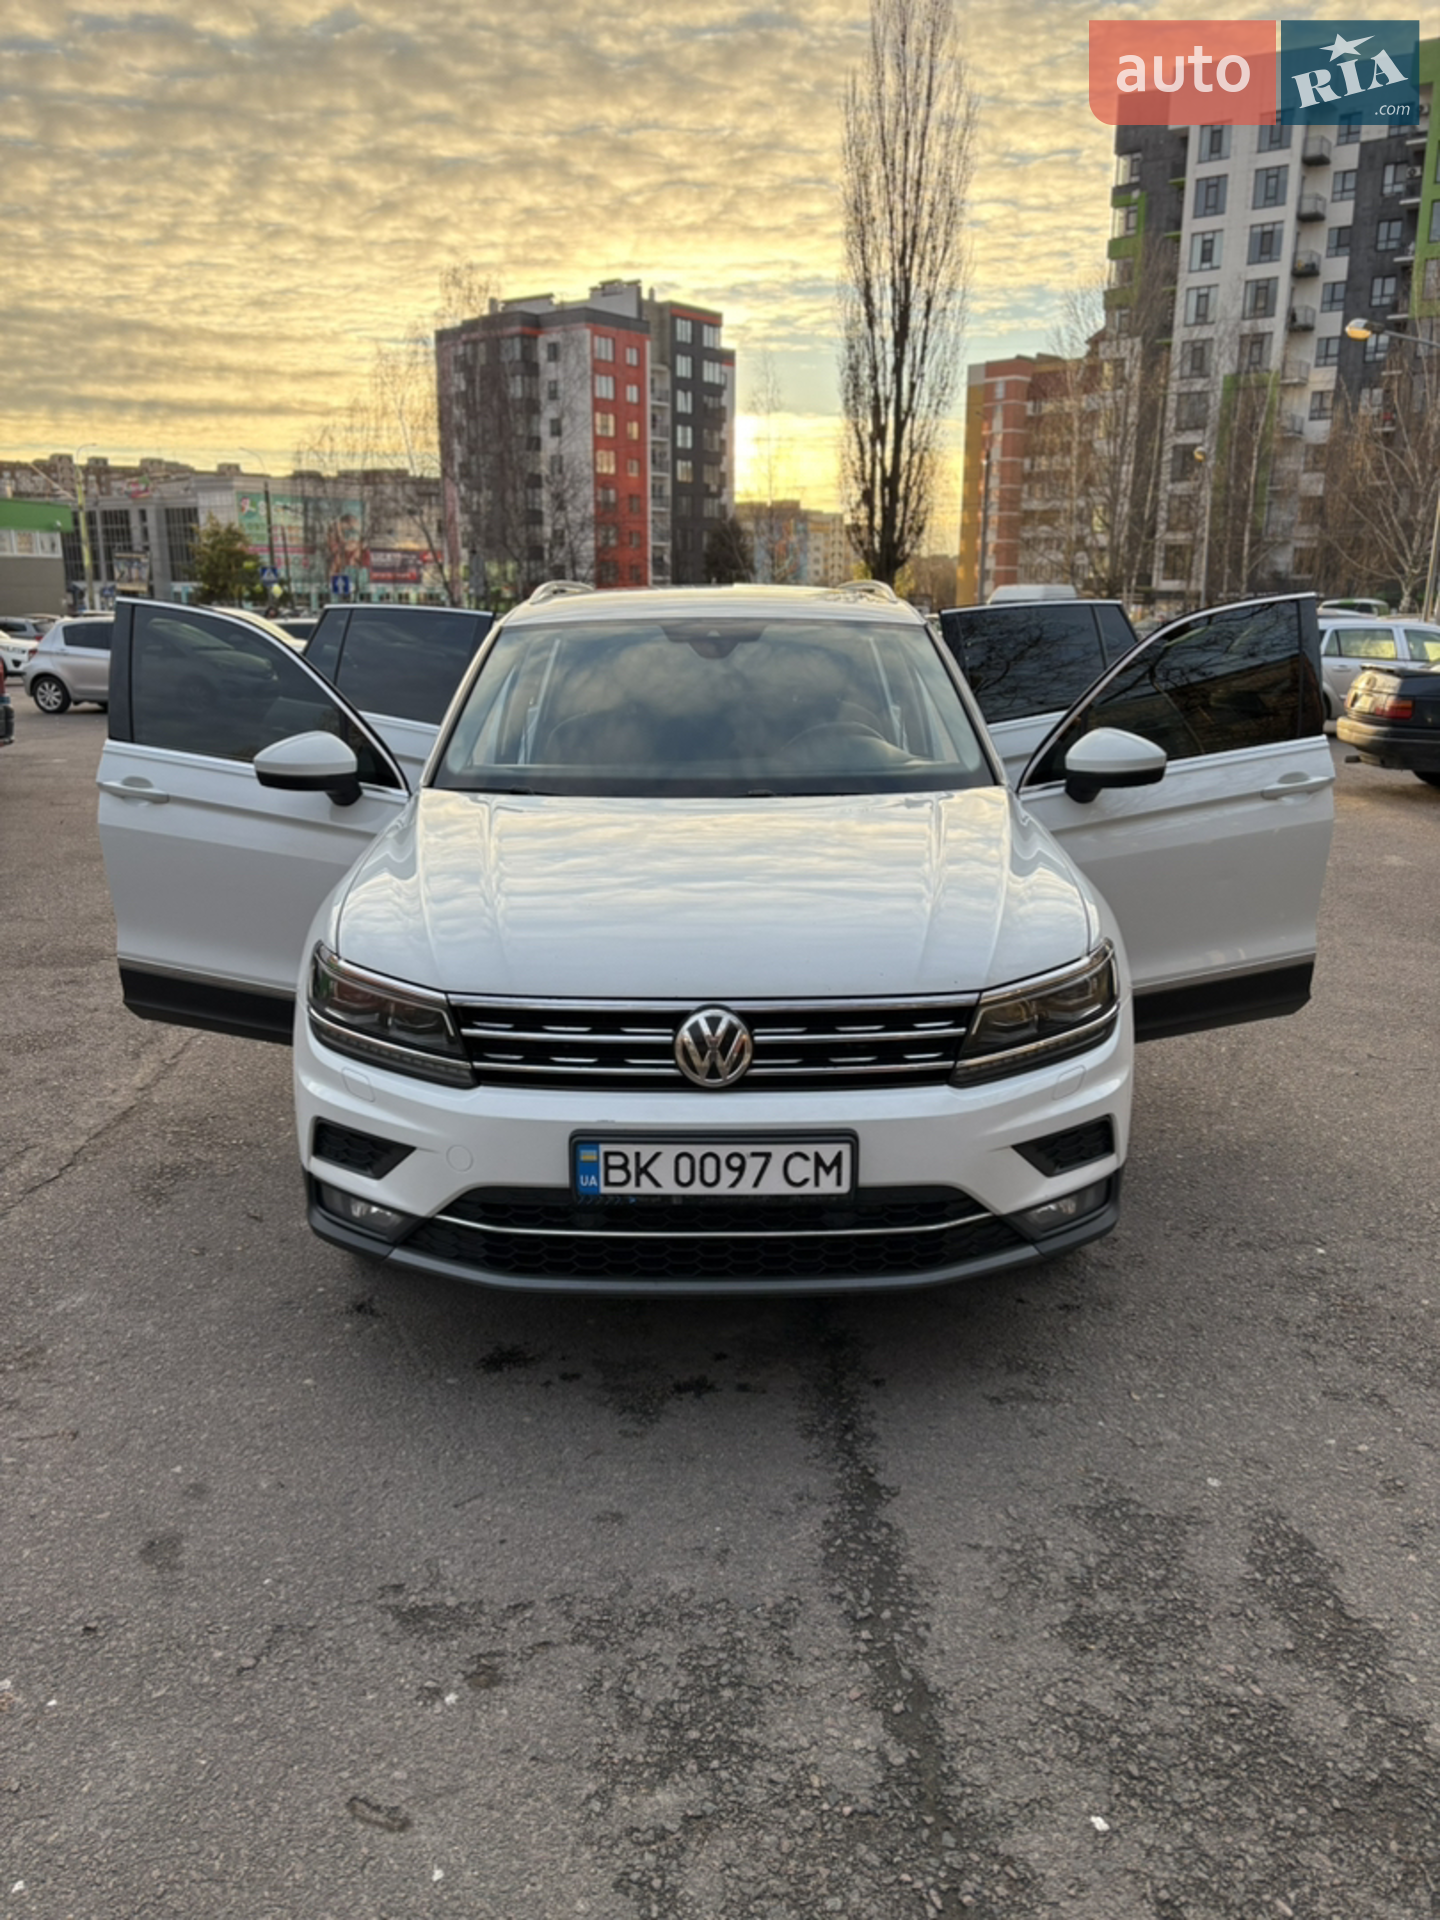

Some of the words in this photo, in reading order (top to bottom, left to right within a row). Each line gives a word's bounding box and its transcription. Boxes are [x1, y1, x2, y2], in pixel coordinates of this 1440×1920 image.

[580, 1175, 598, 1188] UA
[603, 1151, 663, 1188] BK
[674, 1151, 772, 1188] 0097
[782, 1151, 843, 1188] CM
